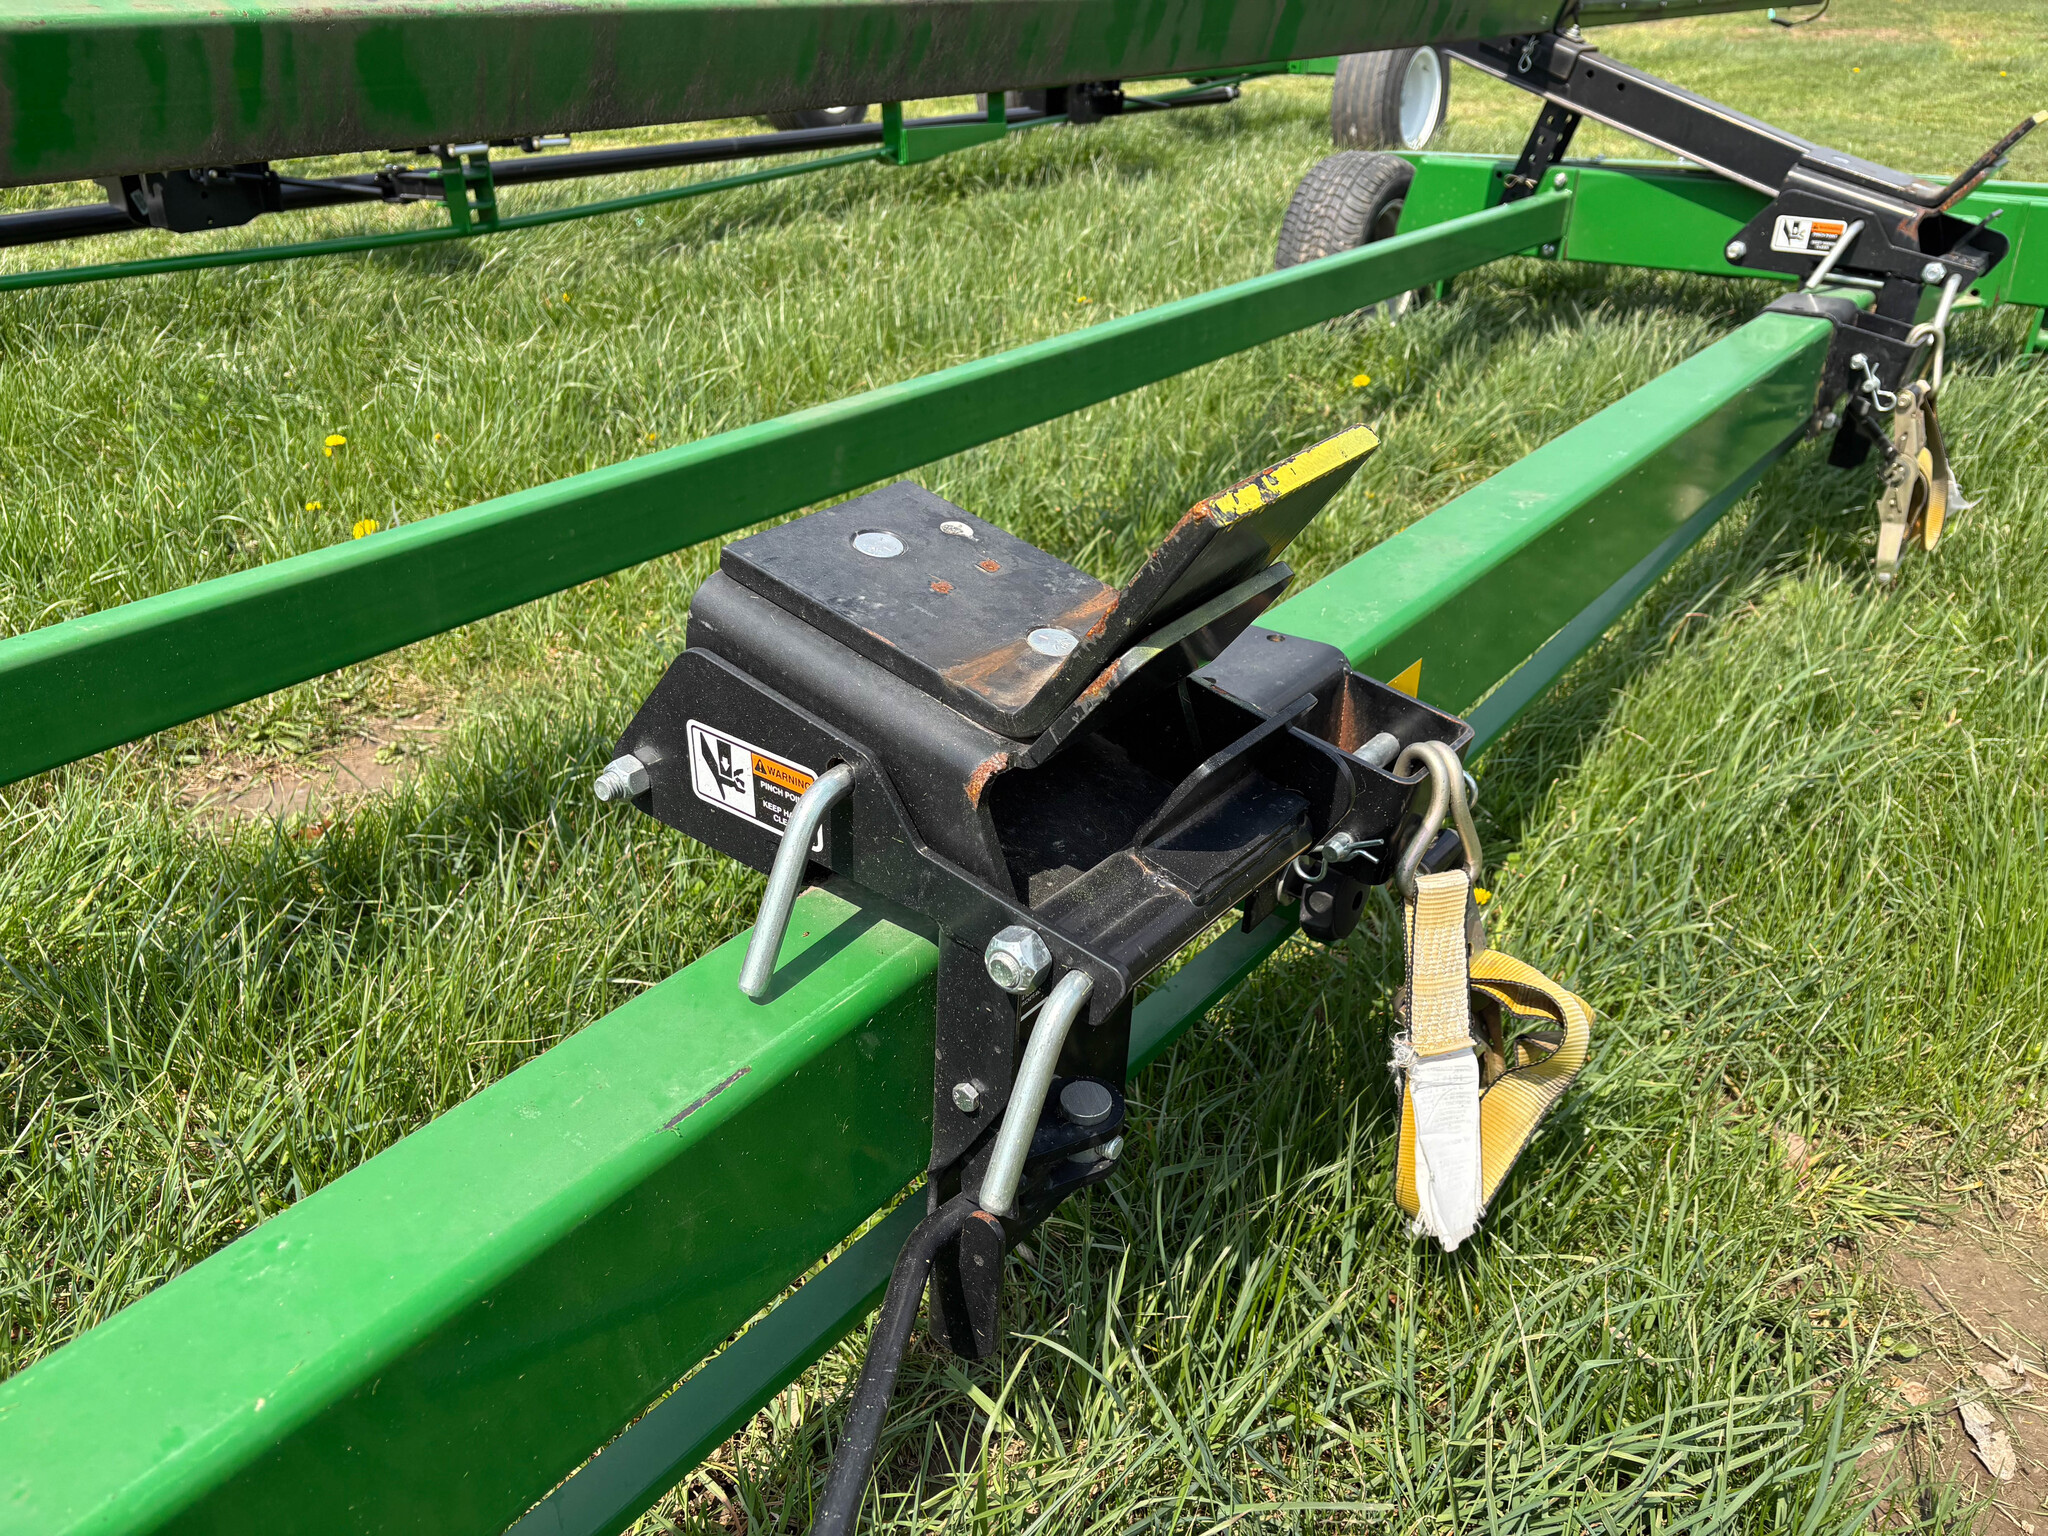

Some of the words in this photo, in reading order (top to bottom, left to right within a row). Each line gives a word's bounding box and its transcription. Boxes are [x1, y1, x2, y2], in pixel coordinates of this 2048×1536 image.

[760, 780, 784, 797] PINCH
[762, 800, 782, 813] KEEP
[773, 814, 788, 826] CLE
